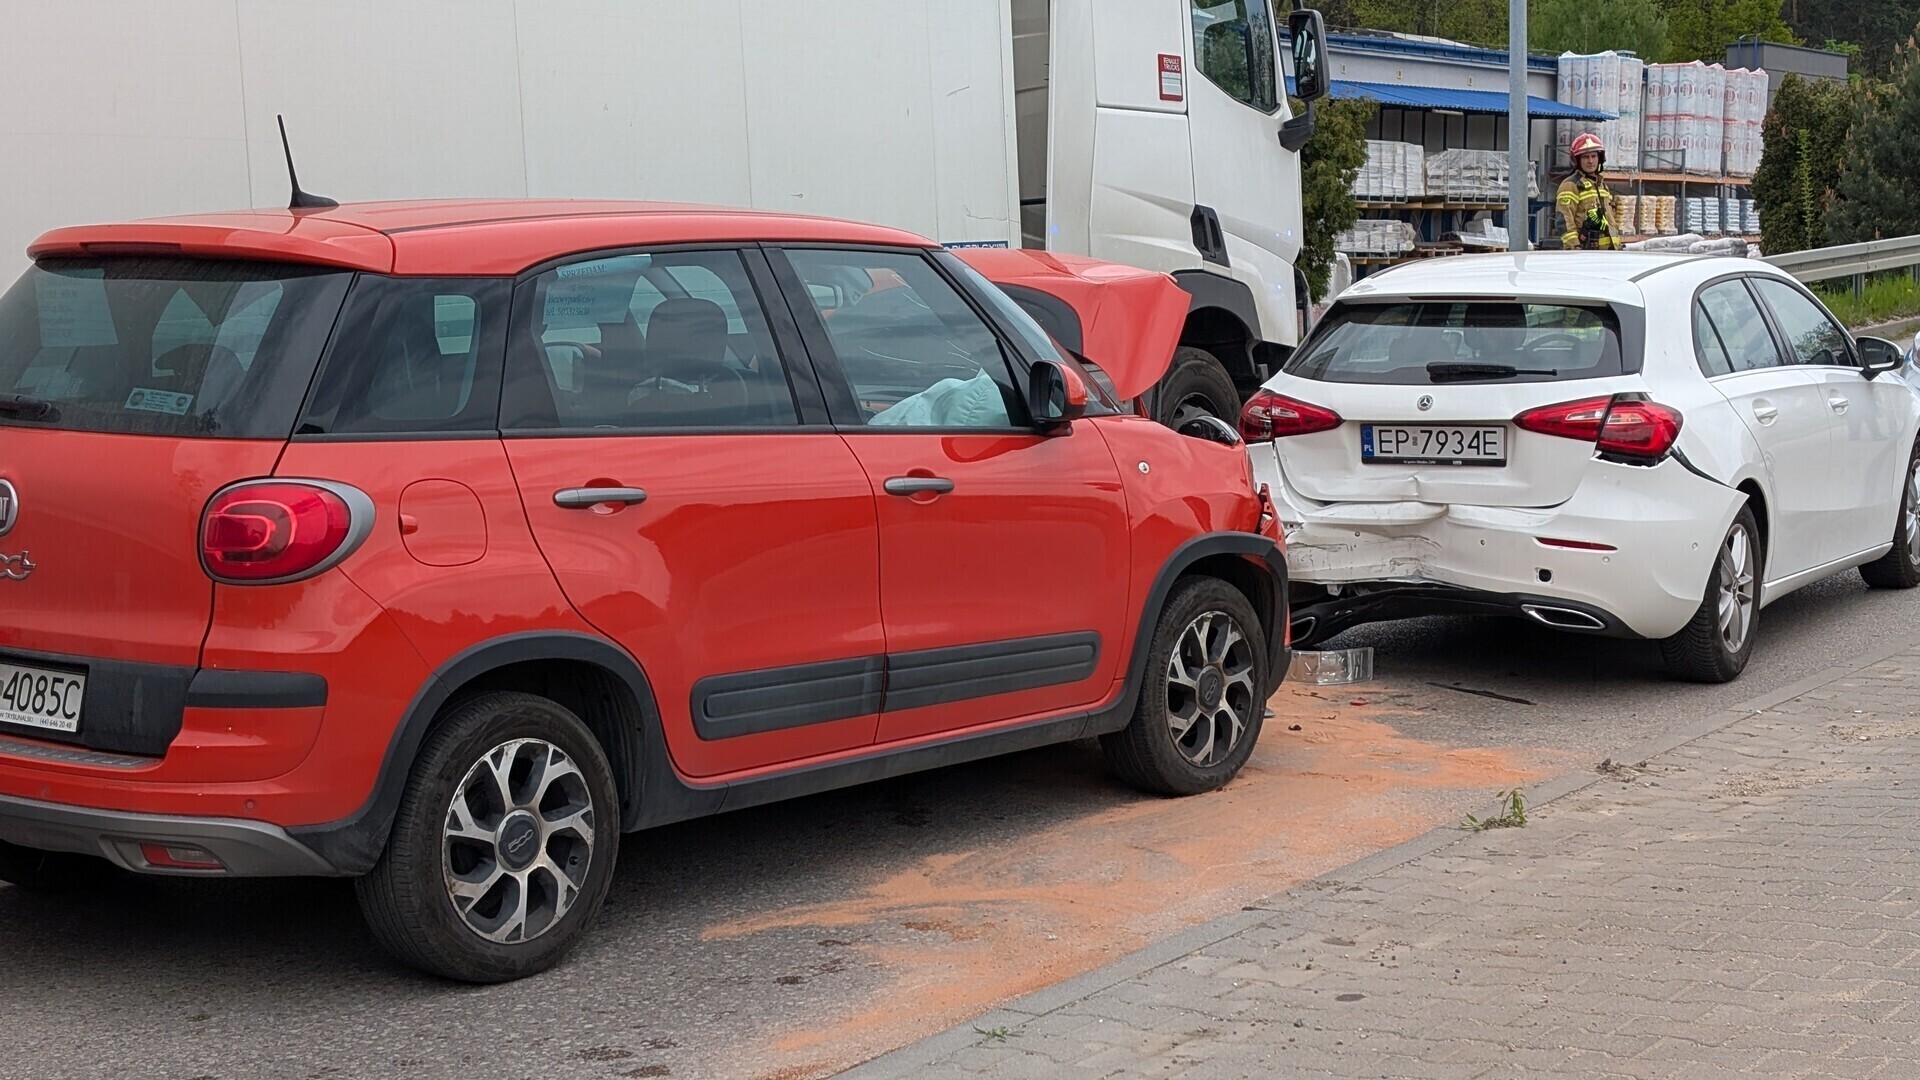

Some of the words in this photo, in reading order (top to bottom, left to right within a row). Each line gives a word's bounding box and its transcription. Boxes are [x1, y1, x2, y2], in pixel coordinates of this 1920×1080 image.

[1163, 57, 1180, 65] RENAULT
[1364, 444, 1373, 452] PL
[1378, 429, 1410, 454] EP
[1420, 429, 1498, 456] 7934E
[2, 671, 81, 720] 4085C
[50, 719, 59, 727] 646
[507, 828, 534, 854] 500
